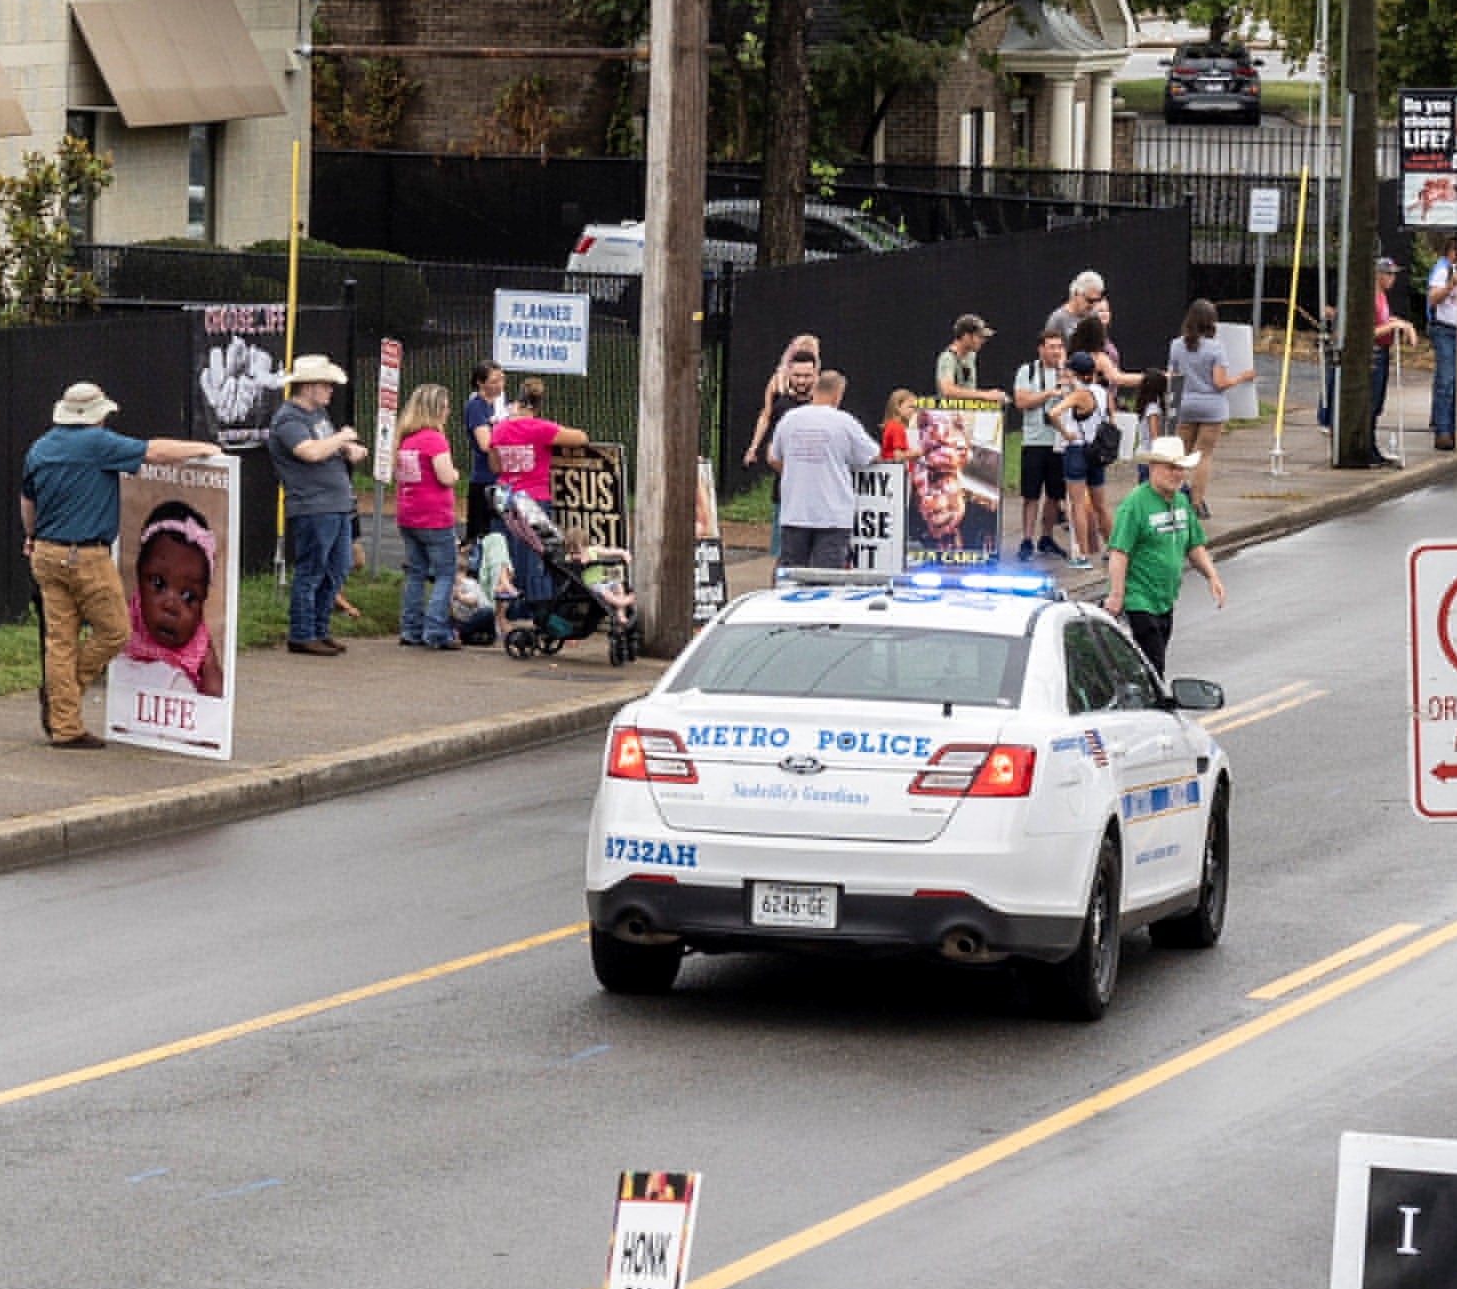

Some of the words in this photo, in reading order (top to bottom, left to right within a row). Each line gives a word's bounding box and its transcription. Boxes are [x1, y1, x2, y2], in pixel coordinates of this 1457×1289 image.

[1404, 130, 1451, 148] LIFE?
[511, 302, 574, 321] PLANNED
[497, 322, 583, 344] PARENTHOOD
[510, 343, 570, 362] PARKING
[550, 469, 614, 513] ESUS
[685, 725, 791, 749] METRO
[817, 729, 934, 758] POLICE
[1395, 1204, 1422, 1256] I
[619, 1230, 673, 1280] HONK
